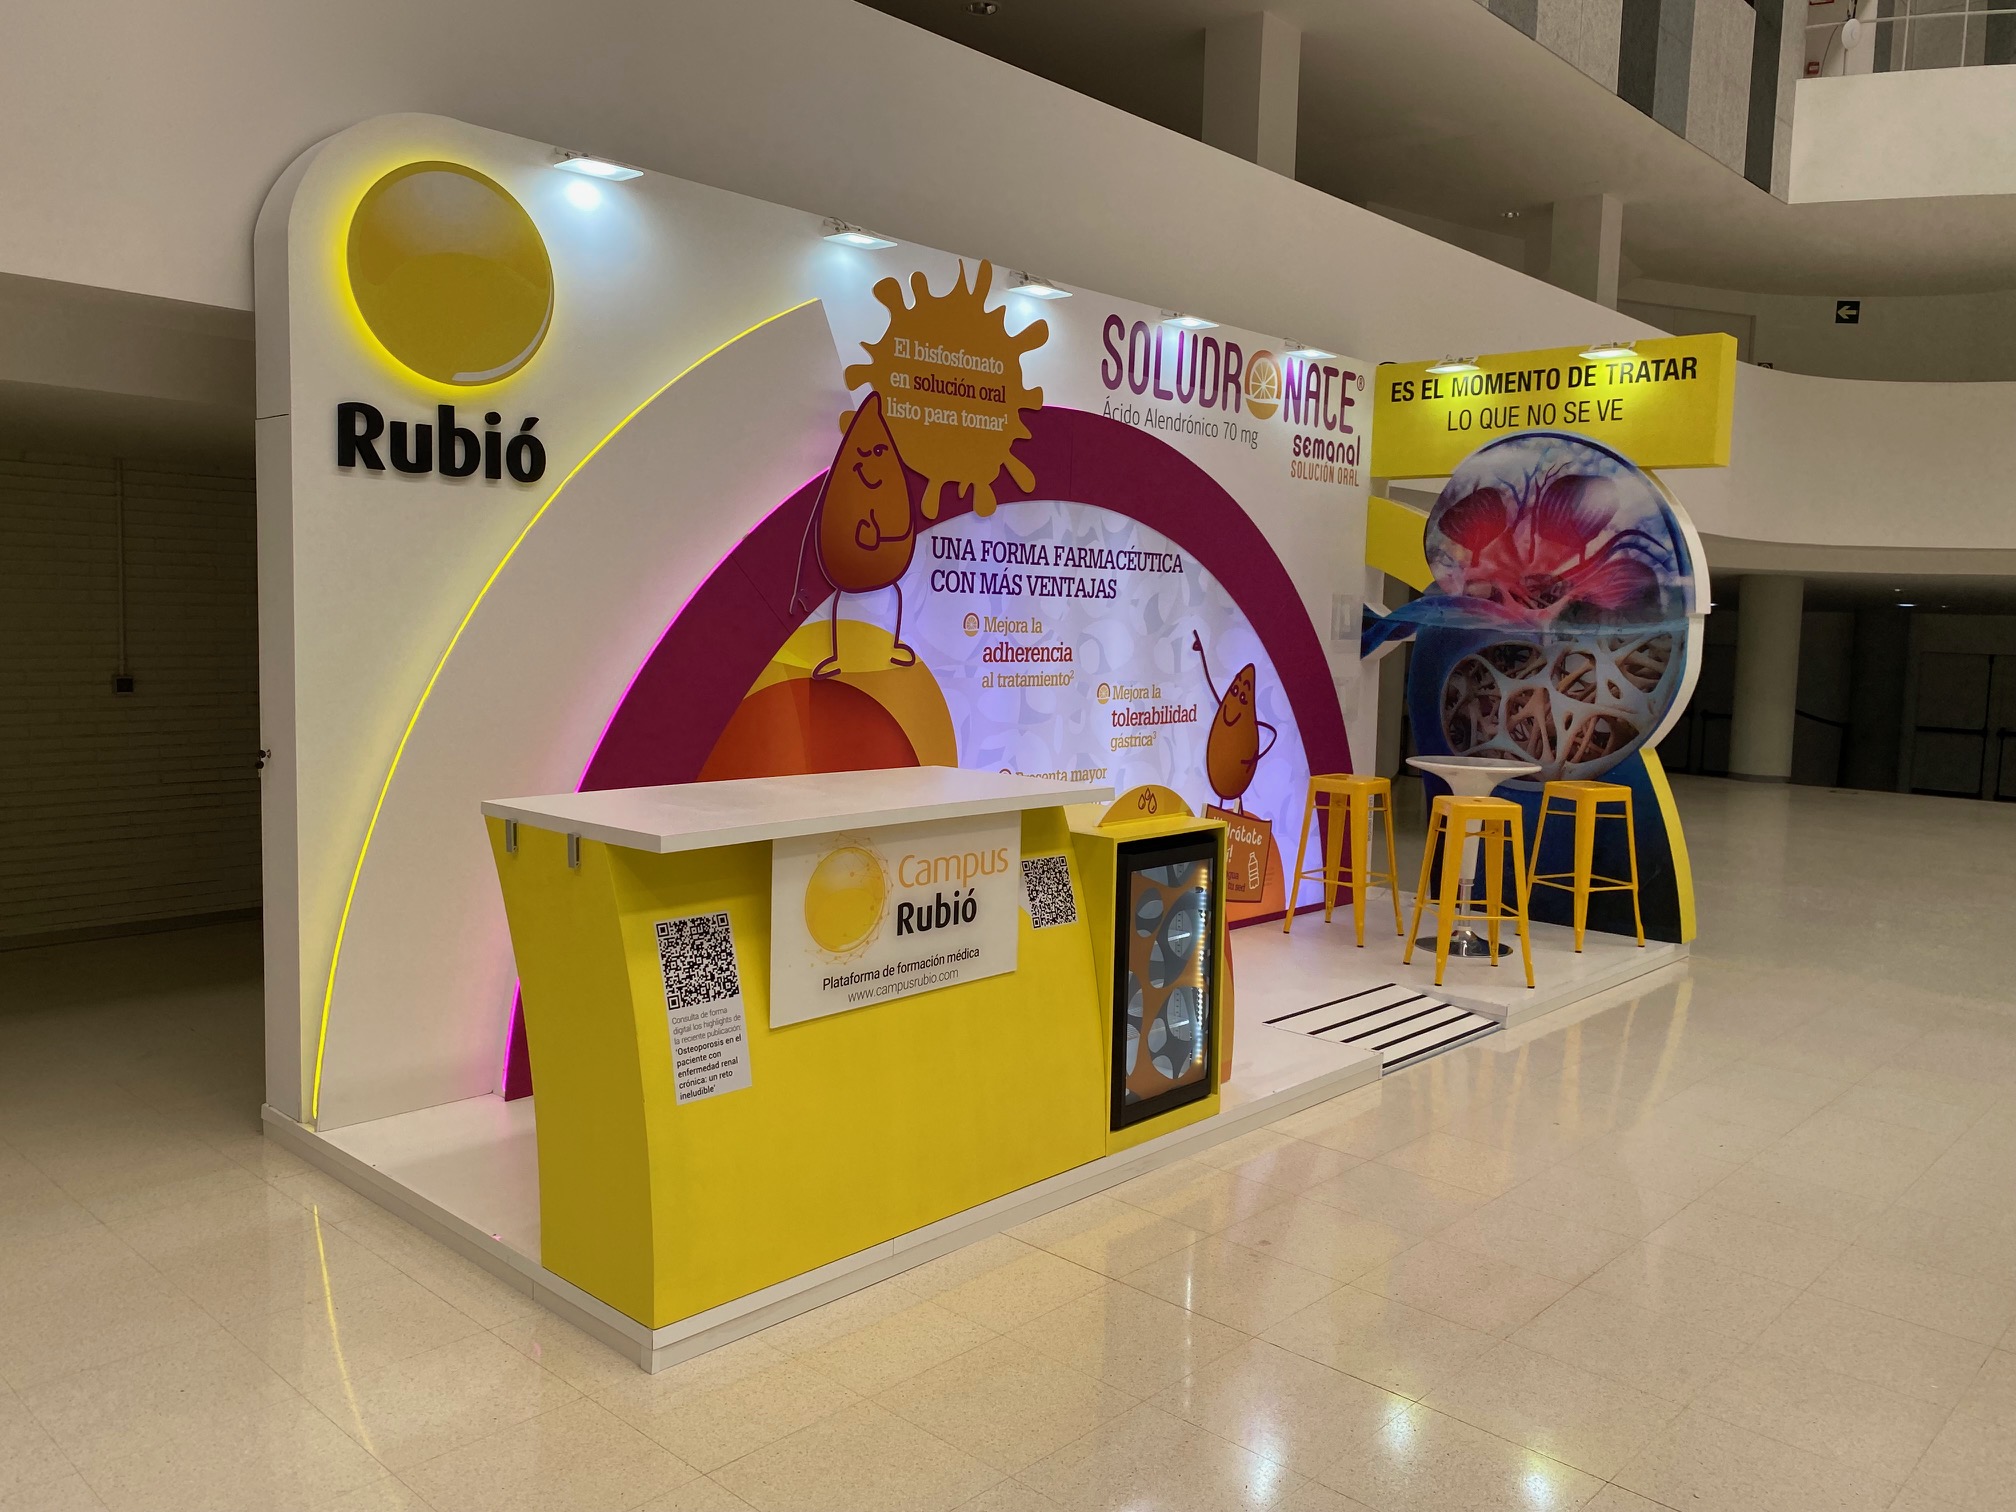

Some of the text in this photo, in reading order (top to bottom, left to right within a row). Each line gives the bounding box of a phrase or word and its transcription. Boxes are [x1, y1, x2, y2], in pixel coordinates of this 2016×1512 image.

[894, 337, 1004, 375] El bisfosfonato
[890, 372, 1006, 403] en solución oral
[1391, 356, 1697, 402] ES EL MOMENTO DE TRATAR
[887, 397, 921, 420] listo
[924, 407, 958, 425] para
[1103, 396, 1259, 449] Ácido Alendrónico 70 mg
[1447, 398, 1624, 431] LO QUE NO SE VE
[338, 402, 546, 482] Rubió
[1293, 434, 1360, 466] semanal
[1291, 460, 1359, 487] SOLUCIÓN ORAL
[931, 536, 1183, 573] UNA FORMA FARMACÉUTICA
[931, 567, 1117, 599] CON MÁS VENTAJAS
[984, 616, 1043, 636] Mejora la
[982, 641, 1073, 663] adherencia
[982, 672, 994, 688] al
[1112, 684, 1161, 702] Mejora la
[1112, 704, 1197, 727] tolerabilidad
[1070, 768, 1108, 784] mayor
[898, 848, 1009, 888] Campus
[896, 888, 978, 936] Rubió
[823, 947, 980, 991] Plataforma de formación médica
[847, 968, 959, 1003] www.campusrubio.com
[672, 1008, 728, 1024] Consulta de forma
[673, 1024, 692, 1036] digital
[692, 1022, 702, 1030] los
[703, 1016, 732, 1029] highlights
[681, 1033, 706, 1044] reciente
[735, 1034, 742, 1042] el
[676, 1050, 722, 1069] paciente con
[677, 1056, 738, 1078] enfermedad renal
[679, 1076, 707, 1089] crónica:
[719, 1070, 733, 1079] reto
